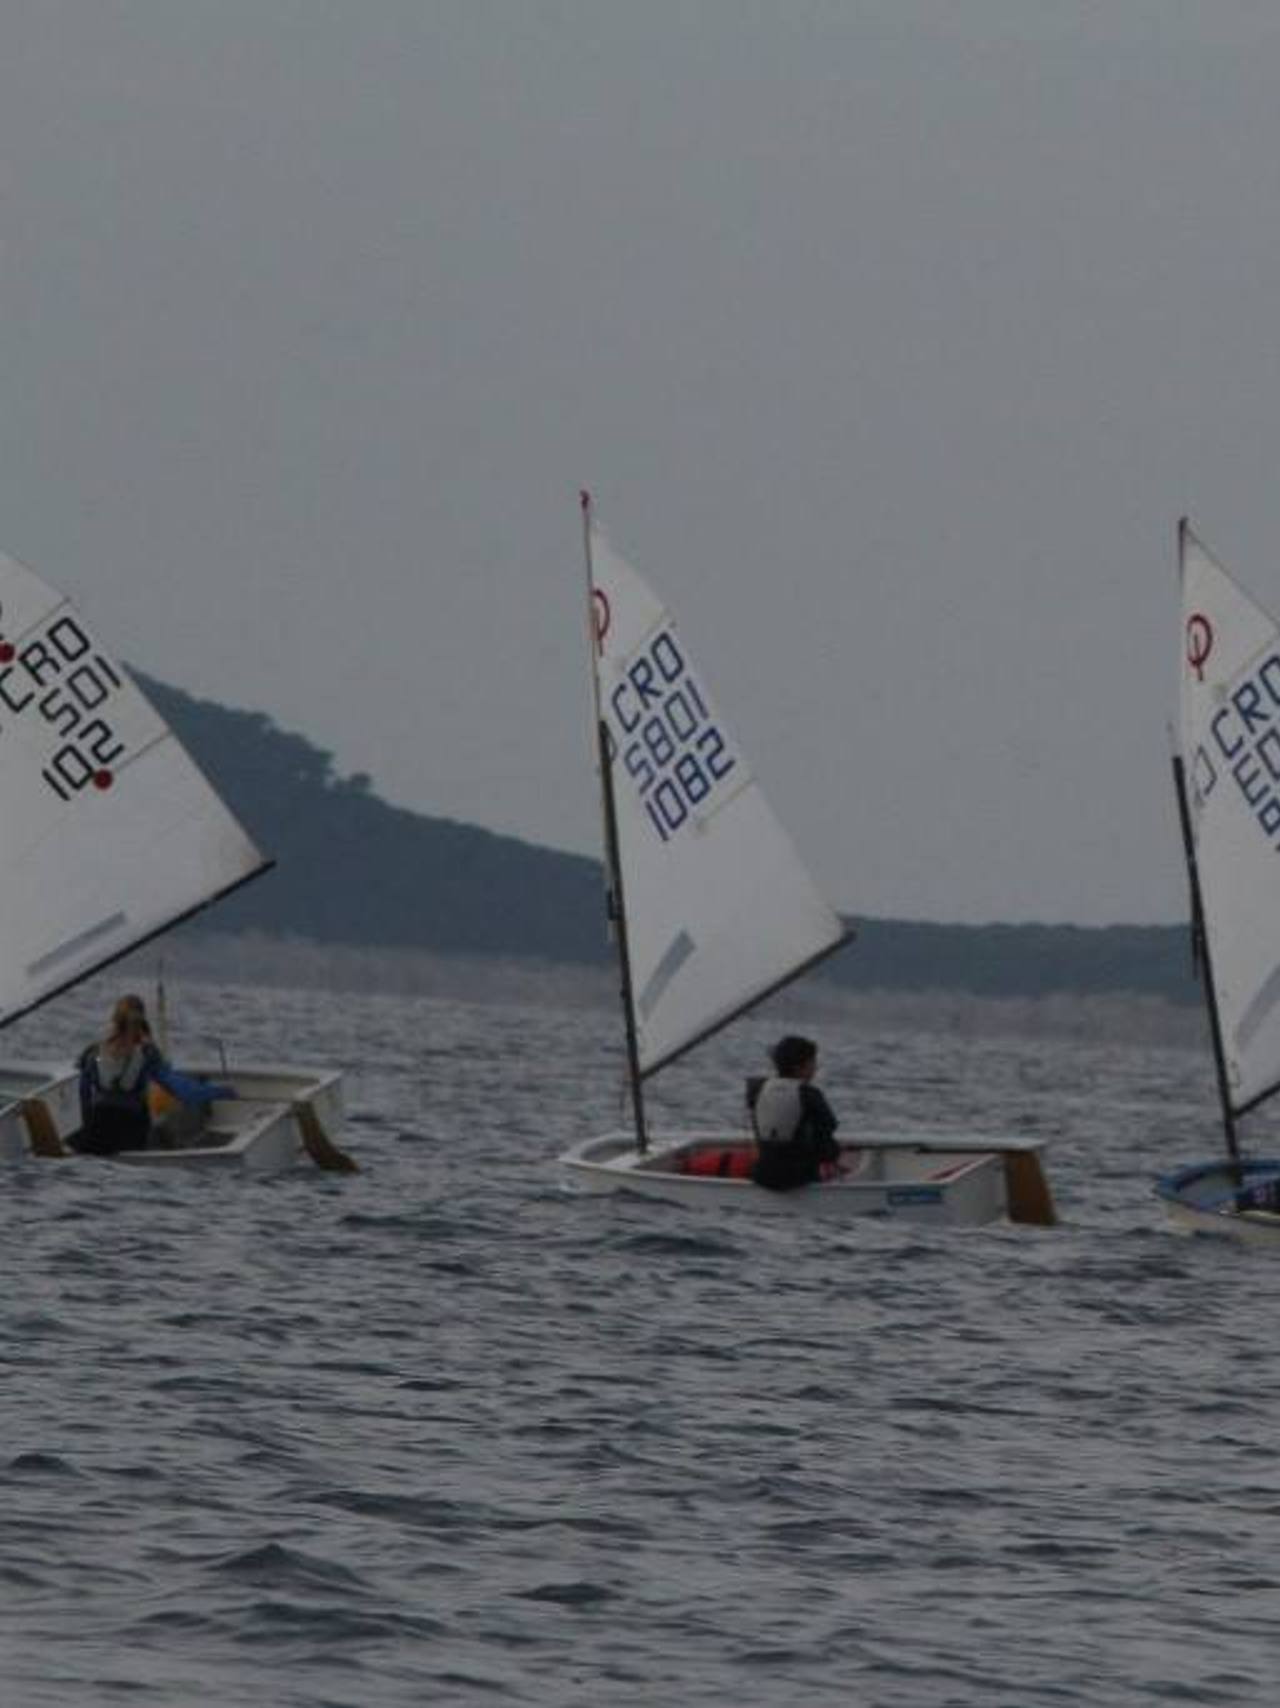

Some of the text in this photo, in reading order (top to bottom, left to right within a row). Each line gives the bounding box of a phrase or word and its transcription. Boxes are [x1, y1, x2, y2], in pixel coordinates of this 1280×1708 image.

[0, 617, 90, 713] CRO
[611, 631, 684, 734] CRO
[42, 719, 125, 801] 102
[645, 727, 735, 841] 1082
